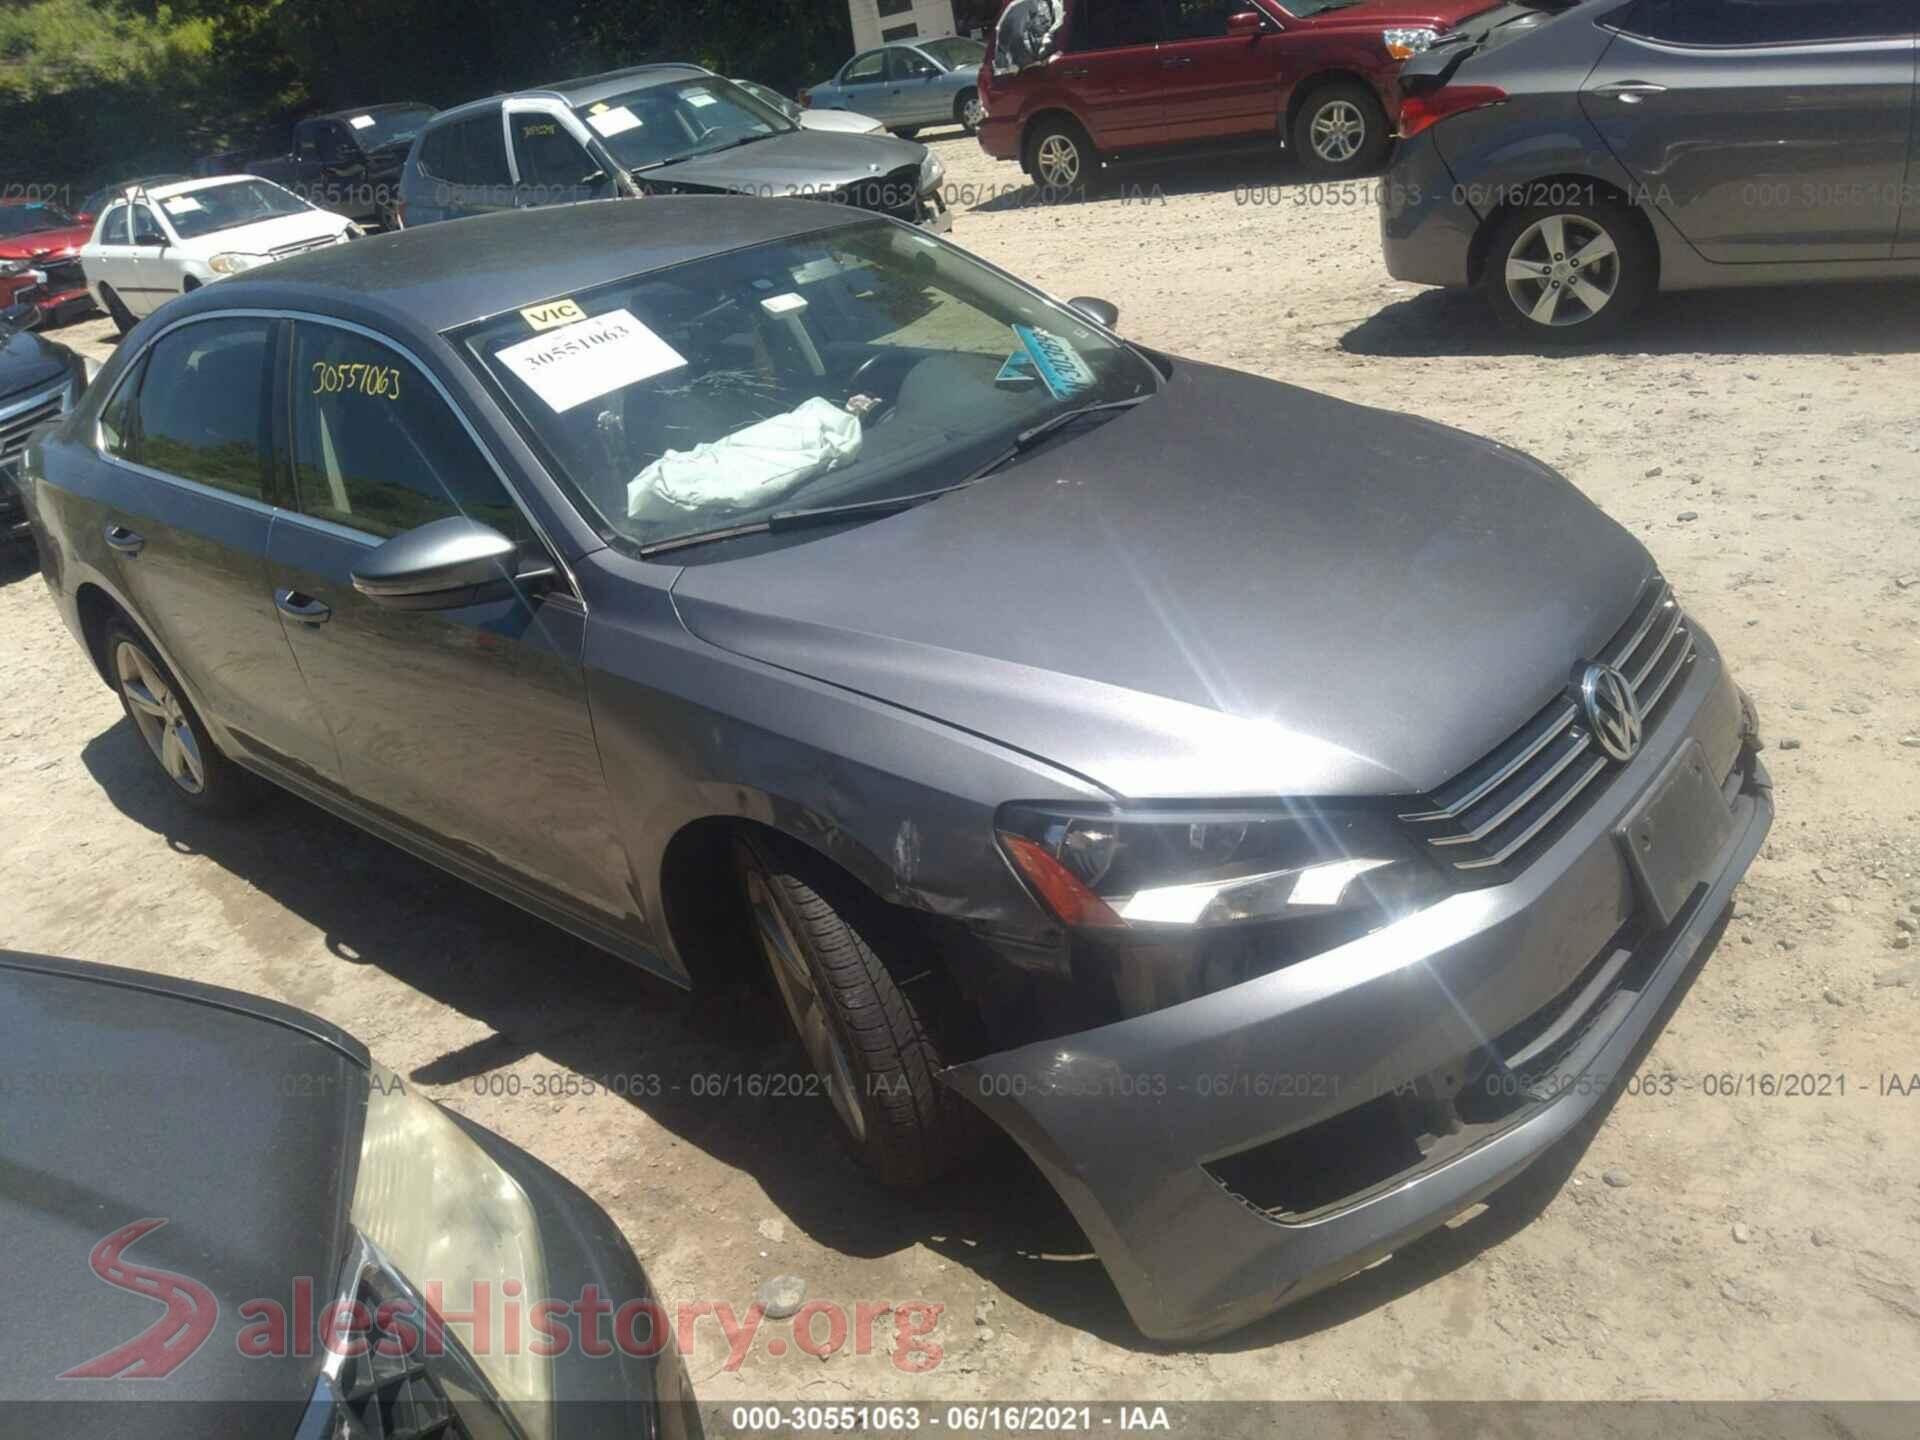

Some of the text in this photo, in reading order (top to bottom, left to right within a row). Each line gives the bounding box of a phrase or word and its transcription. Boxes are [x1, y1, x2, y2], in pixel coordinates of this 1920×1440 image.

[530, 304, 578, 323] VIC
[524, 324, 630, 371] 30551063
[312, 361, 400, 400] 30551063
